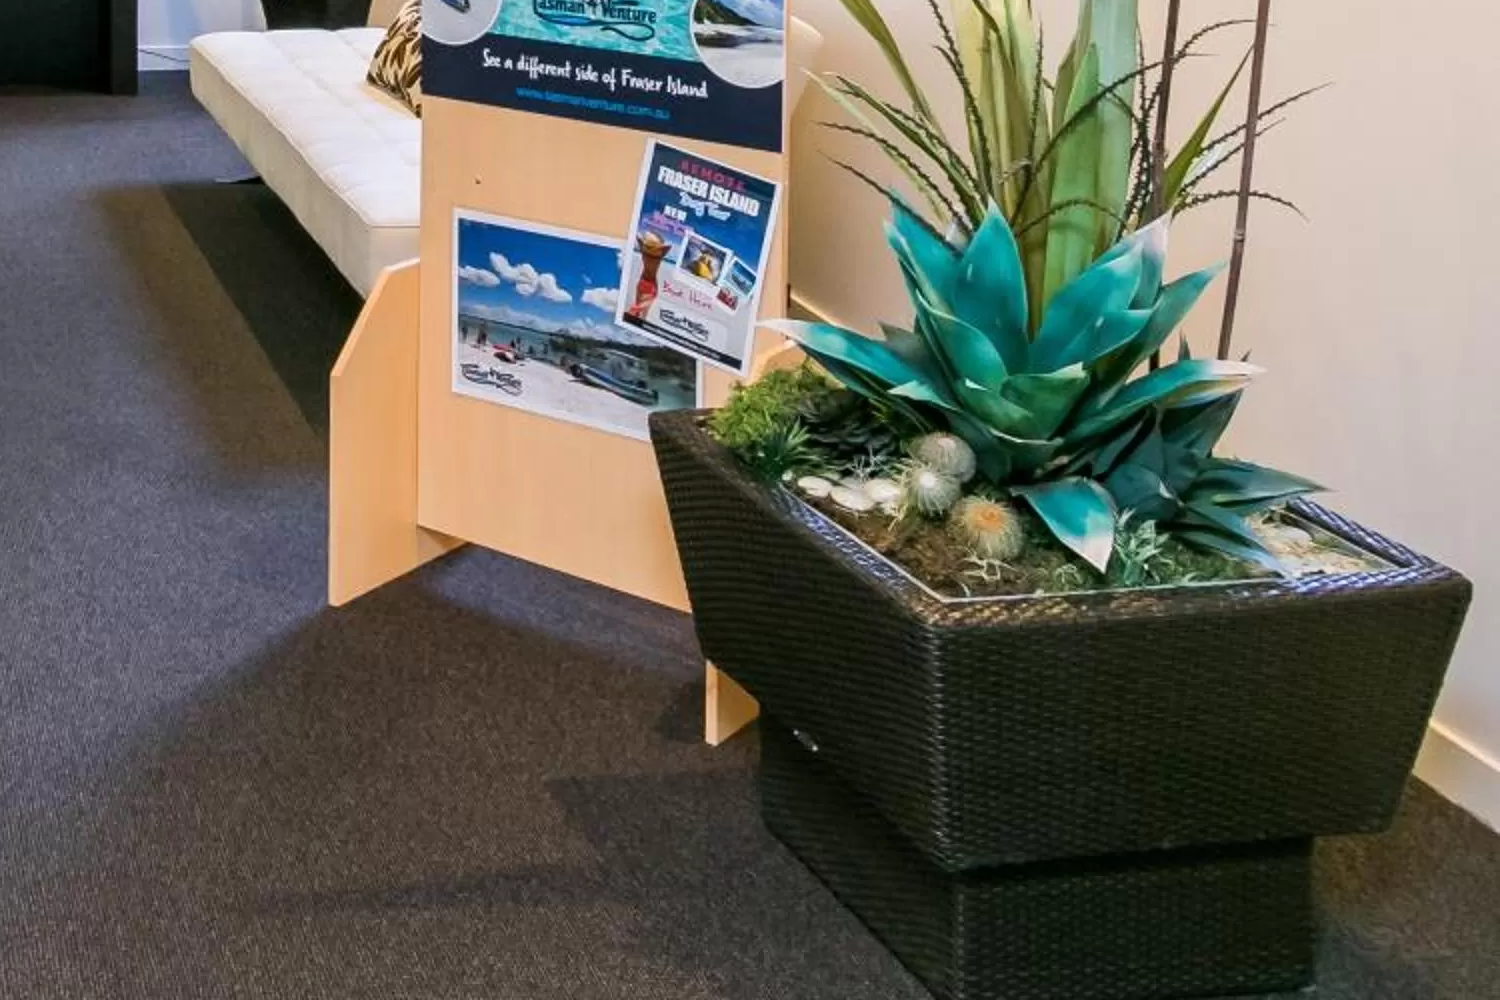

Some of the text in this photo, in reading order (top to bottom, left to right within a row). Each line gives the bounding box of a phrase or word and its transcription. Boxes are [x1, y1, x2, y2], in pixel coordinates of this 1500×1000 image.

[482, 47, 708, 99] See a different side of Fraser Island
[657, 165, 760, 217] FRASER ISLAND
